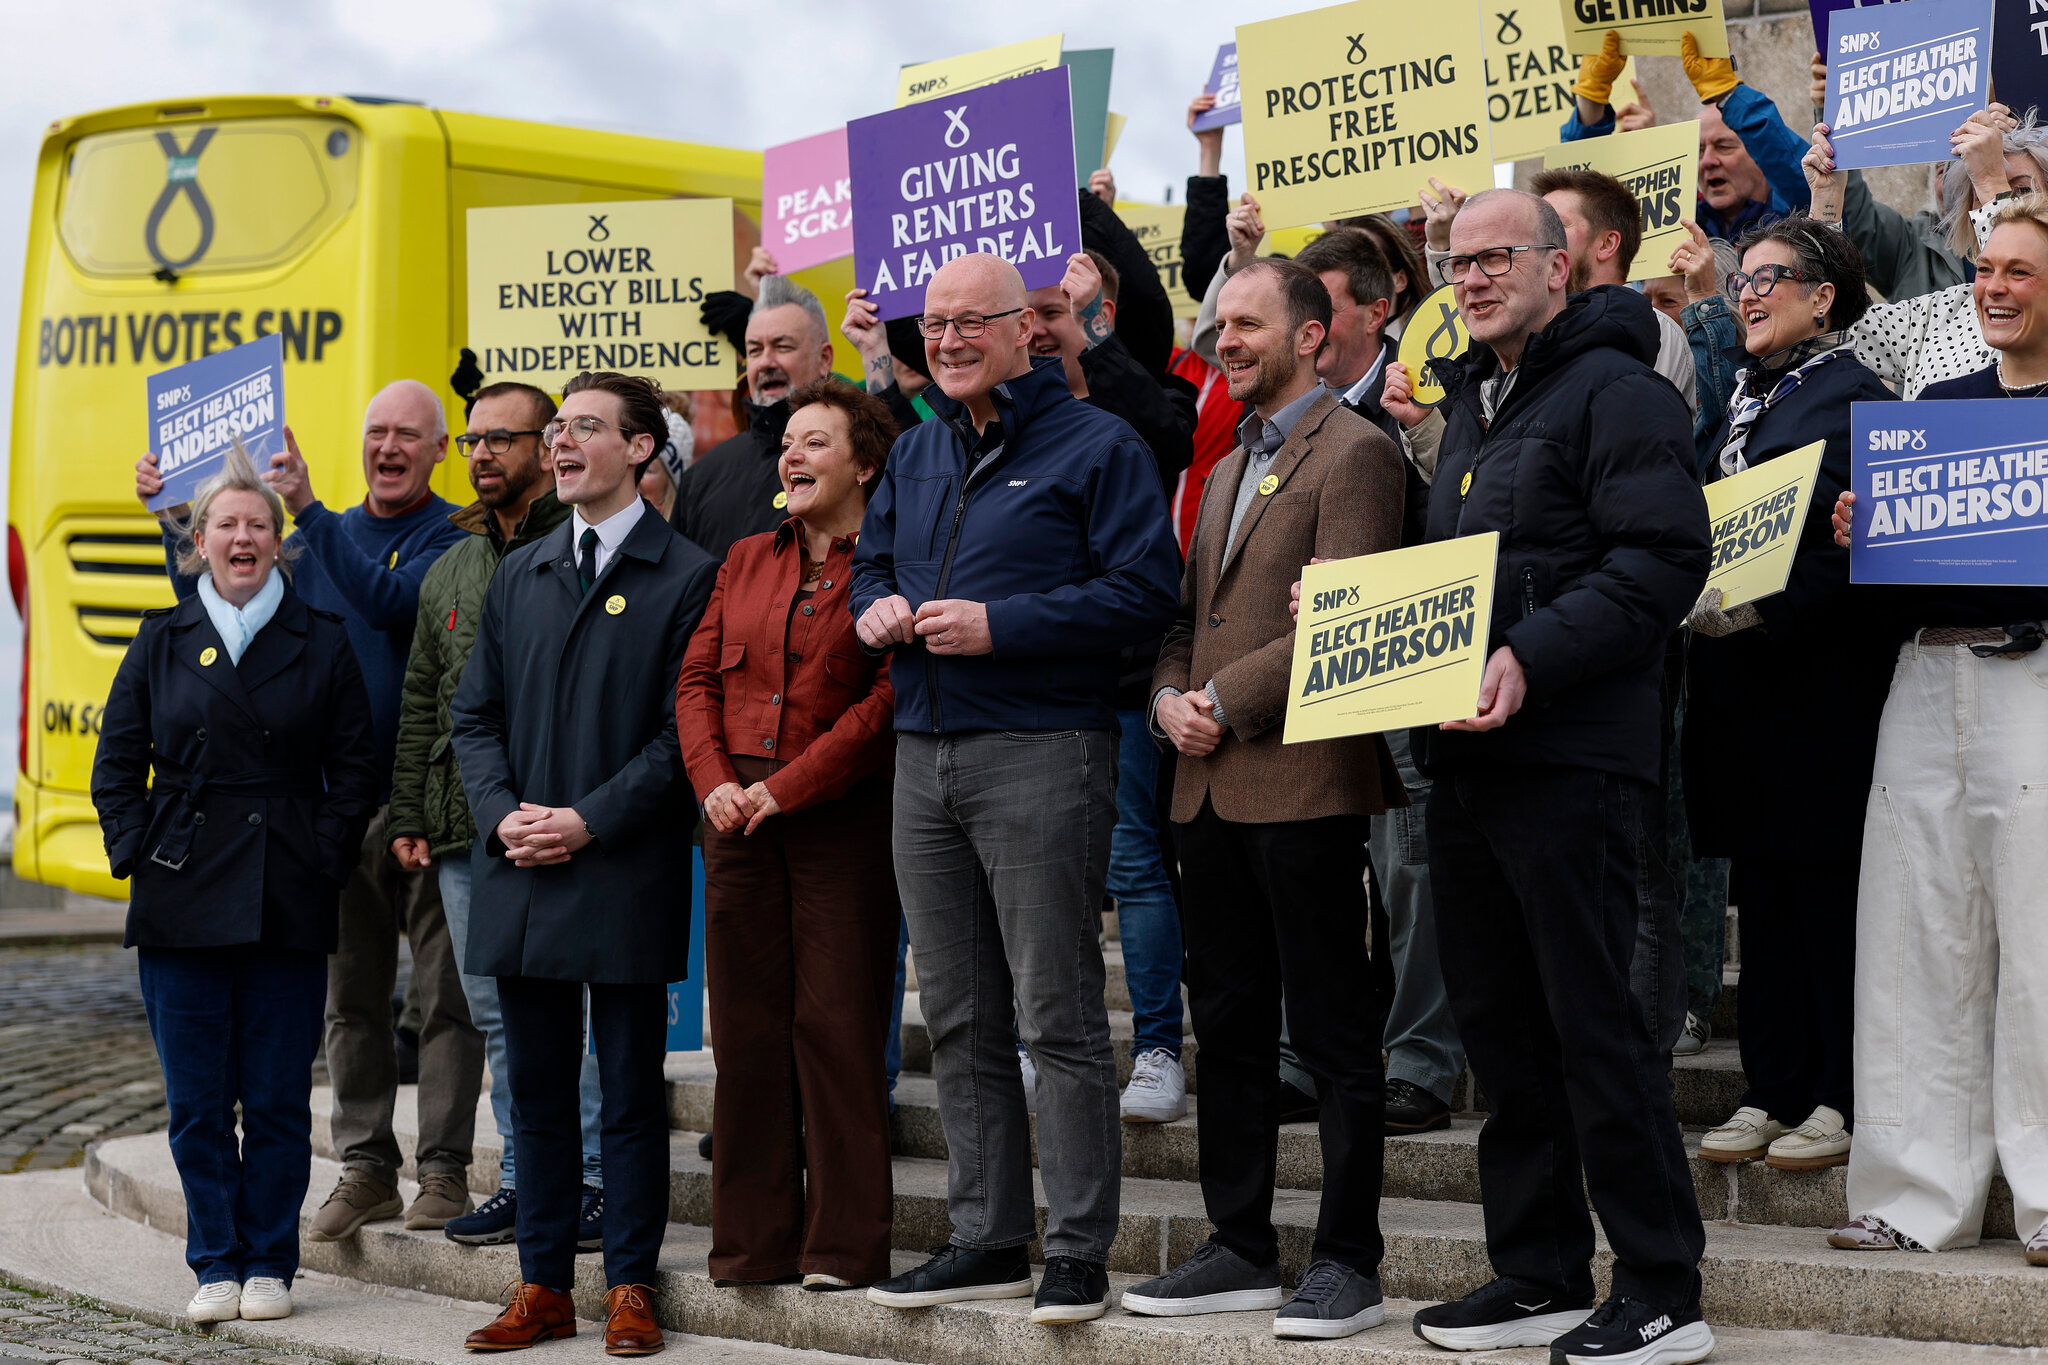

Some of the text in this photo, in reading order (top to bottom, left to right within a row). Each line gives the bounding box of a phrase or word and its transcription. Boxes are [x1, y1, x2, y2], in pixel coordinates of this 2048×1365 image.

[1839, 33, 1869, 54] SNP
[1839, 36, 1977, 95] ELECT HEATHER
[908, 79, 937, 96] SNP
[1266, 54, 1456, 118] PROTECTING
[1833, 60, 1978, 130] ANDERSON
[1329, 102, 1398, 142] FREE
[900, 143, 1020, 202] GIVING
[1255, 123, 1479, 191] PRESCRIPTIONS
[777, 178, 851, 220] PEAK
[891, 183, 1036, 249] RENTERS
[547, 248, 655, 275] LOWER
[872, 258, 898, 295] A
[499, 277, 703, 309] ENERGY BILLS
[39, 315, 117, 366] BOTH
[126, 311, 243, 363] VOTES
[559, 311, 641, 338] WITH
[485, 341, 721, 373] INDEPENDENCE
[157, 388, 182, 410] SNP
[160, 374, 272, 446] ELECT HEATHER
[160, 393, 275, 475] ANDERSON
[1869, 430, 1911, 451] SNP
[1871, 464, 1943, 498] ELECT
[1712, 486, 1798, 544] HEATHER
[1312, 588, 1347, 613] SNP
[1310, 585, 1475, 658] ELECT HEATHER
[1301, 611, 1475, 697] ANDERSON
[44, 702, 74, 734] ON
[1638, 1314, 1673, 1343] HOKA
